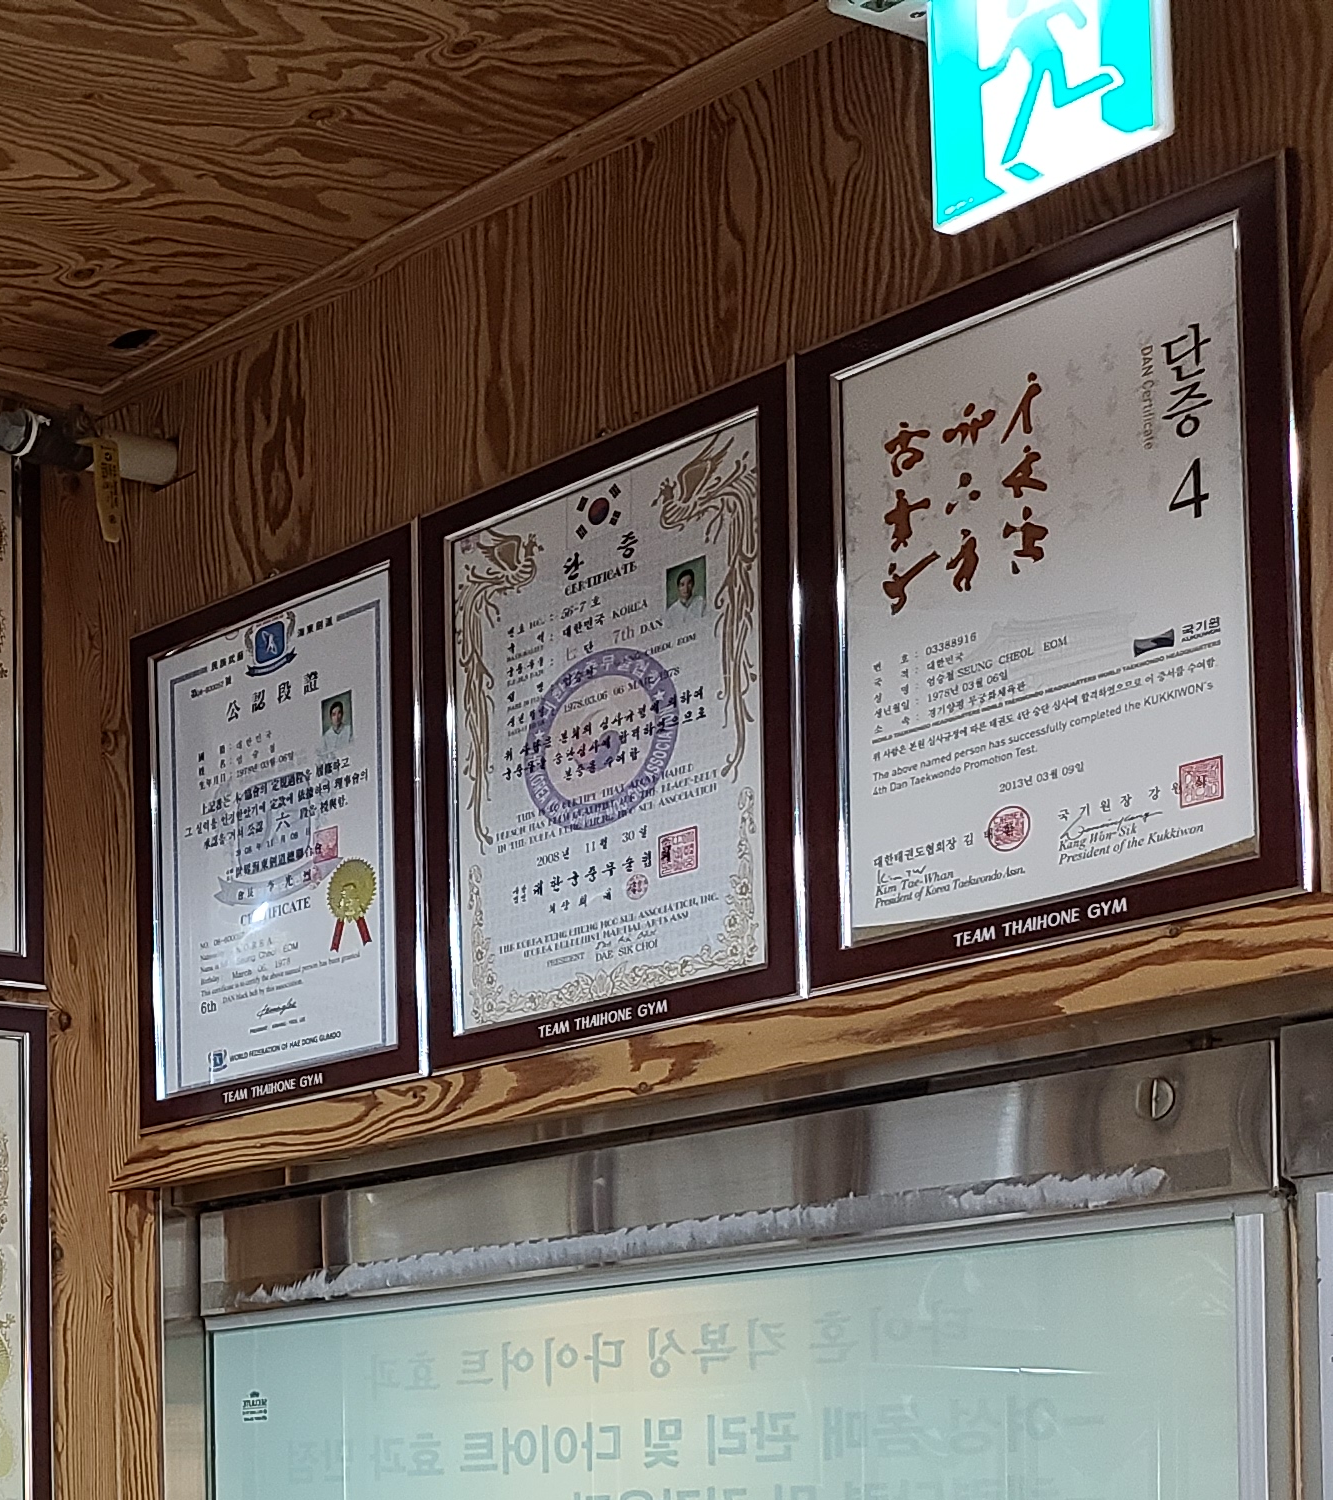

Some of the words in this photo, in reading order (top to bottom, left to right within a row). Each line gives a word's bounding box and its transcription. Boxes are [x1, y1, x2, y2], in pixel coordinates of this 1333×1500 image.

[1160, 323, 1213, 441] 단증
[1168, 457, 1210, 519] 4
[1181, 616, 1221, 636] 국기원
[1008, 720, 1067, 745] successfully
[1070, 705, 1121, 728] completed
[953, 931, 995, 951] TEAM
[1001, 909, 1079, 937] THAIHONE
[1087, 898, 1128, 920] GYM
[538, 1020, 570, 1039] TEAM
[574, 1006, 633, 1031] THAIHONE
[637, 999, 668, 1018] GYM
[223, 1088, 248, 1104] TEAM
[252, 1077, 297, 1099] THAIHONE
[300, 1074, 323, 1089] GYM
